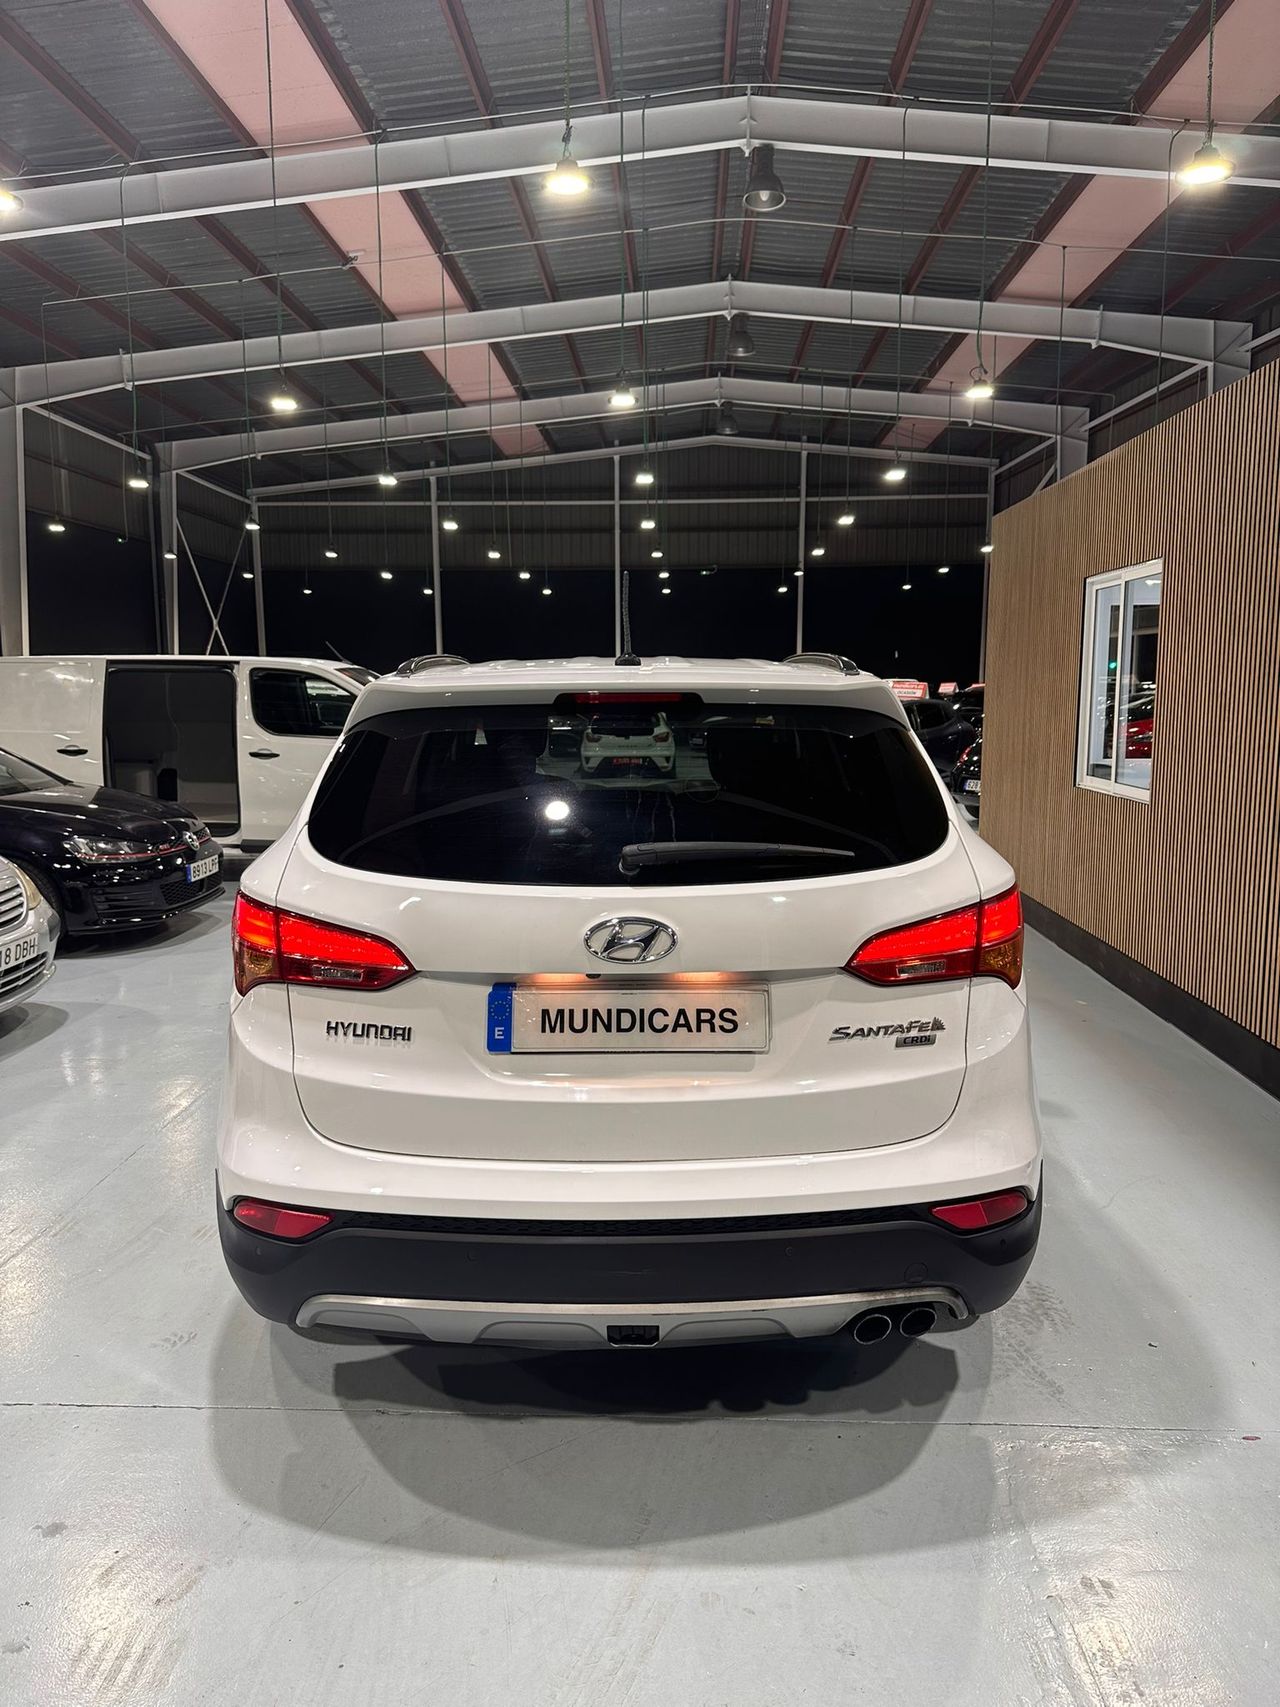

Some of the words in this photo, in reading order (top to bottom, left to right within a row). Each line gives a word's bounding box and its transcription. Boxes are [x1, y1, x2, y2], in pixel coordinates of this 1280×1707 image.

[192, 861, 208, 879] 8913
[15, 937, 36, 961] DBH
[540, 1007, 739, 1034] MUNDICARS
[326, 1020, 412, 1042] HYUNDAI
[494, 1027, 505, 1039] E
[903, 1035, 931, 1045] CRDi
